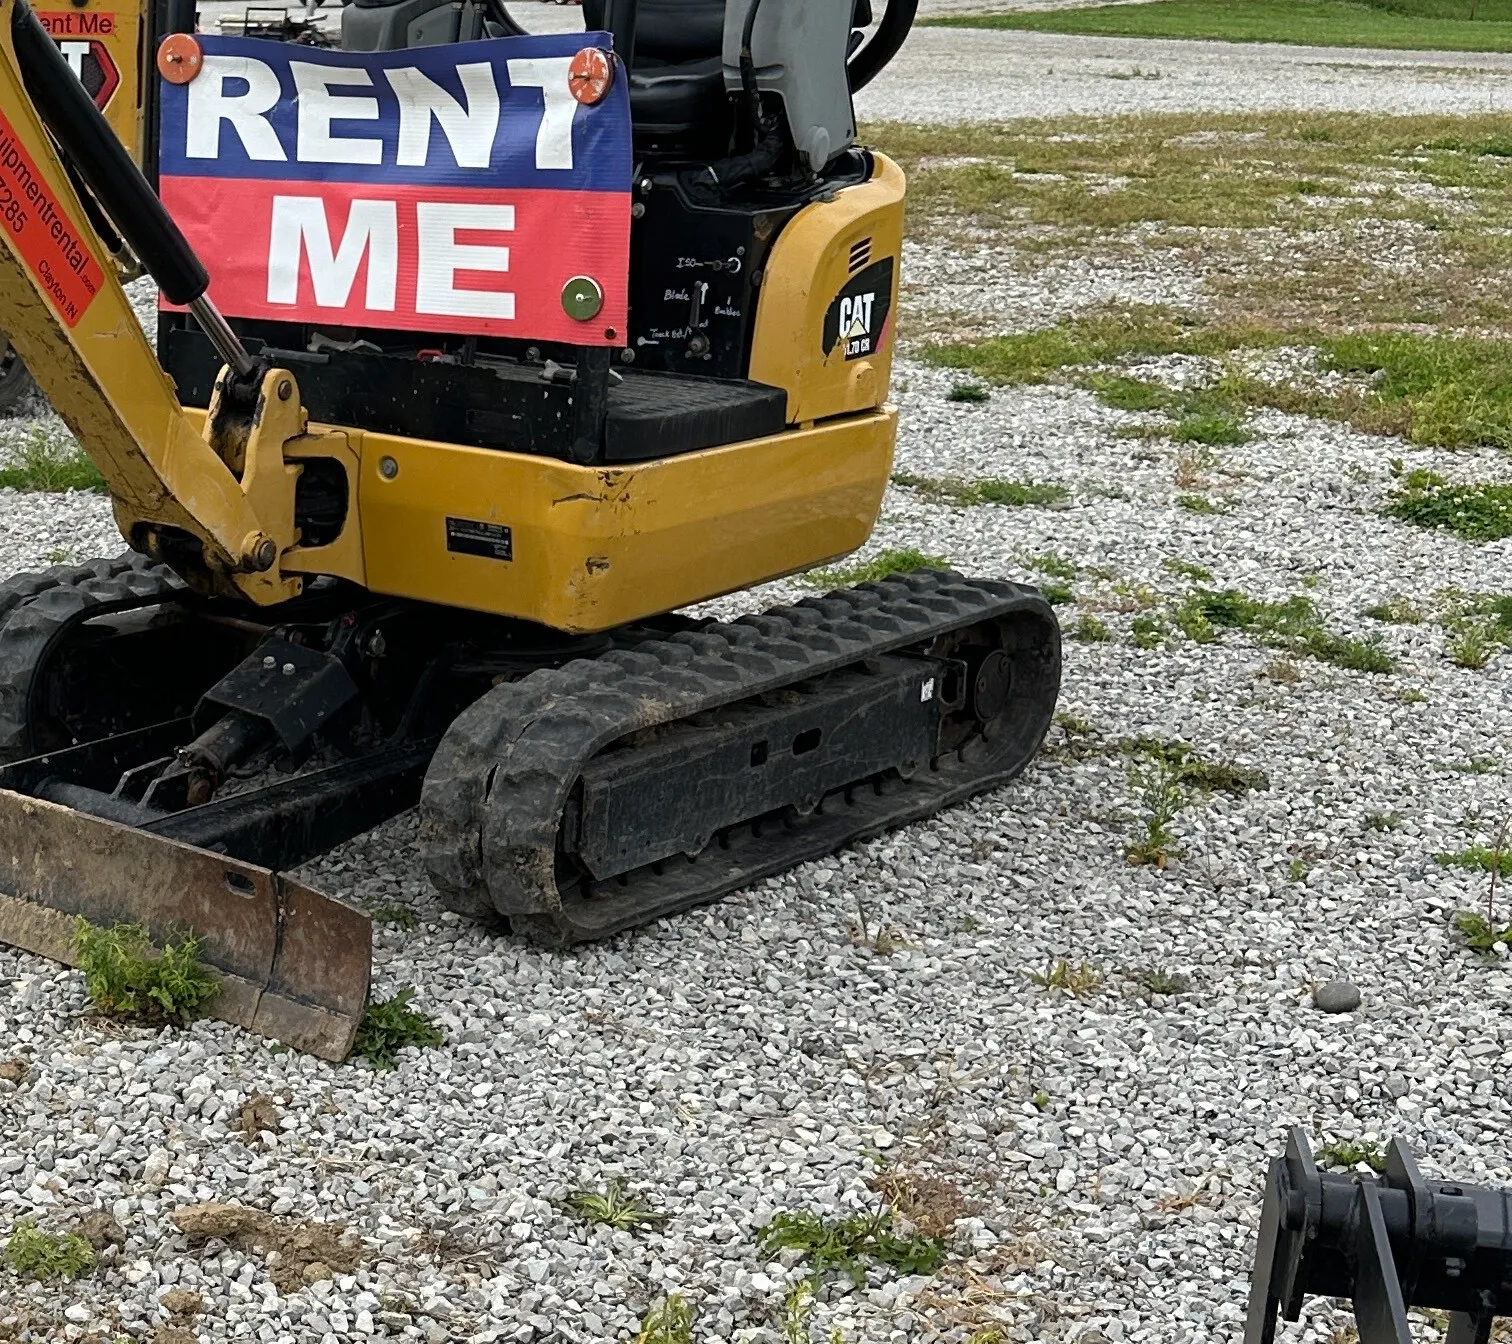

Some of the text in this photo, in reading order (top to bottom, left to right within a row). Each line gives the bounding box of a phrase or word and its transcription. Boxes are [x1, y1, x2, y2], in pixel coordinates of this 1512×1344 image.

[40, 14, 113, 34] ent Me
[186, 56, 577, 169] RENT
[267, 196, 516, 319] ME
[39, 260, 79, 319] Clayton IN
[839, 292, 875, 339] CAT
